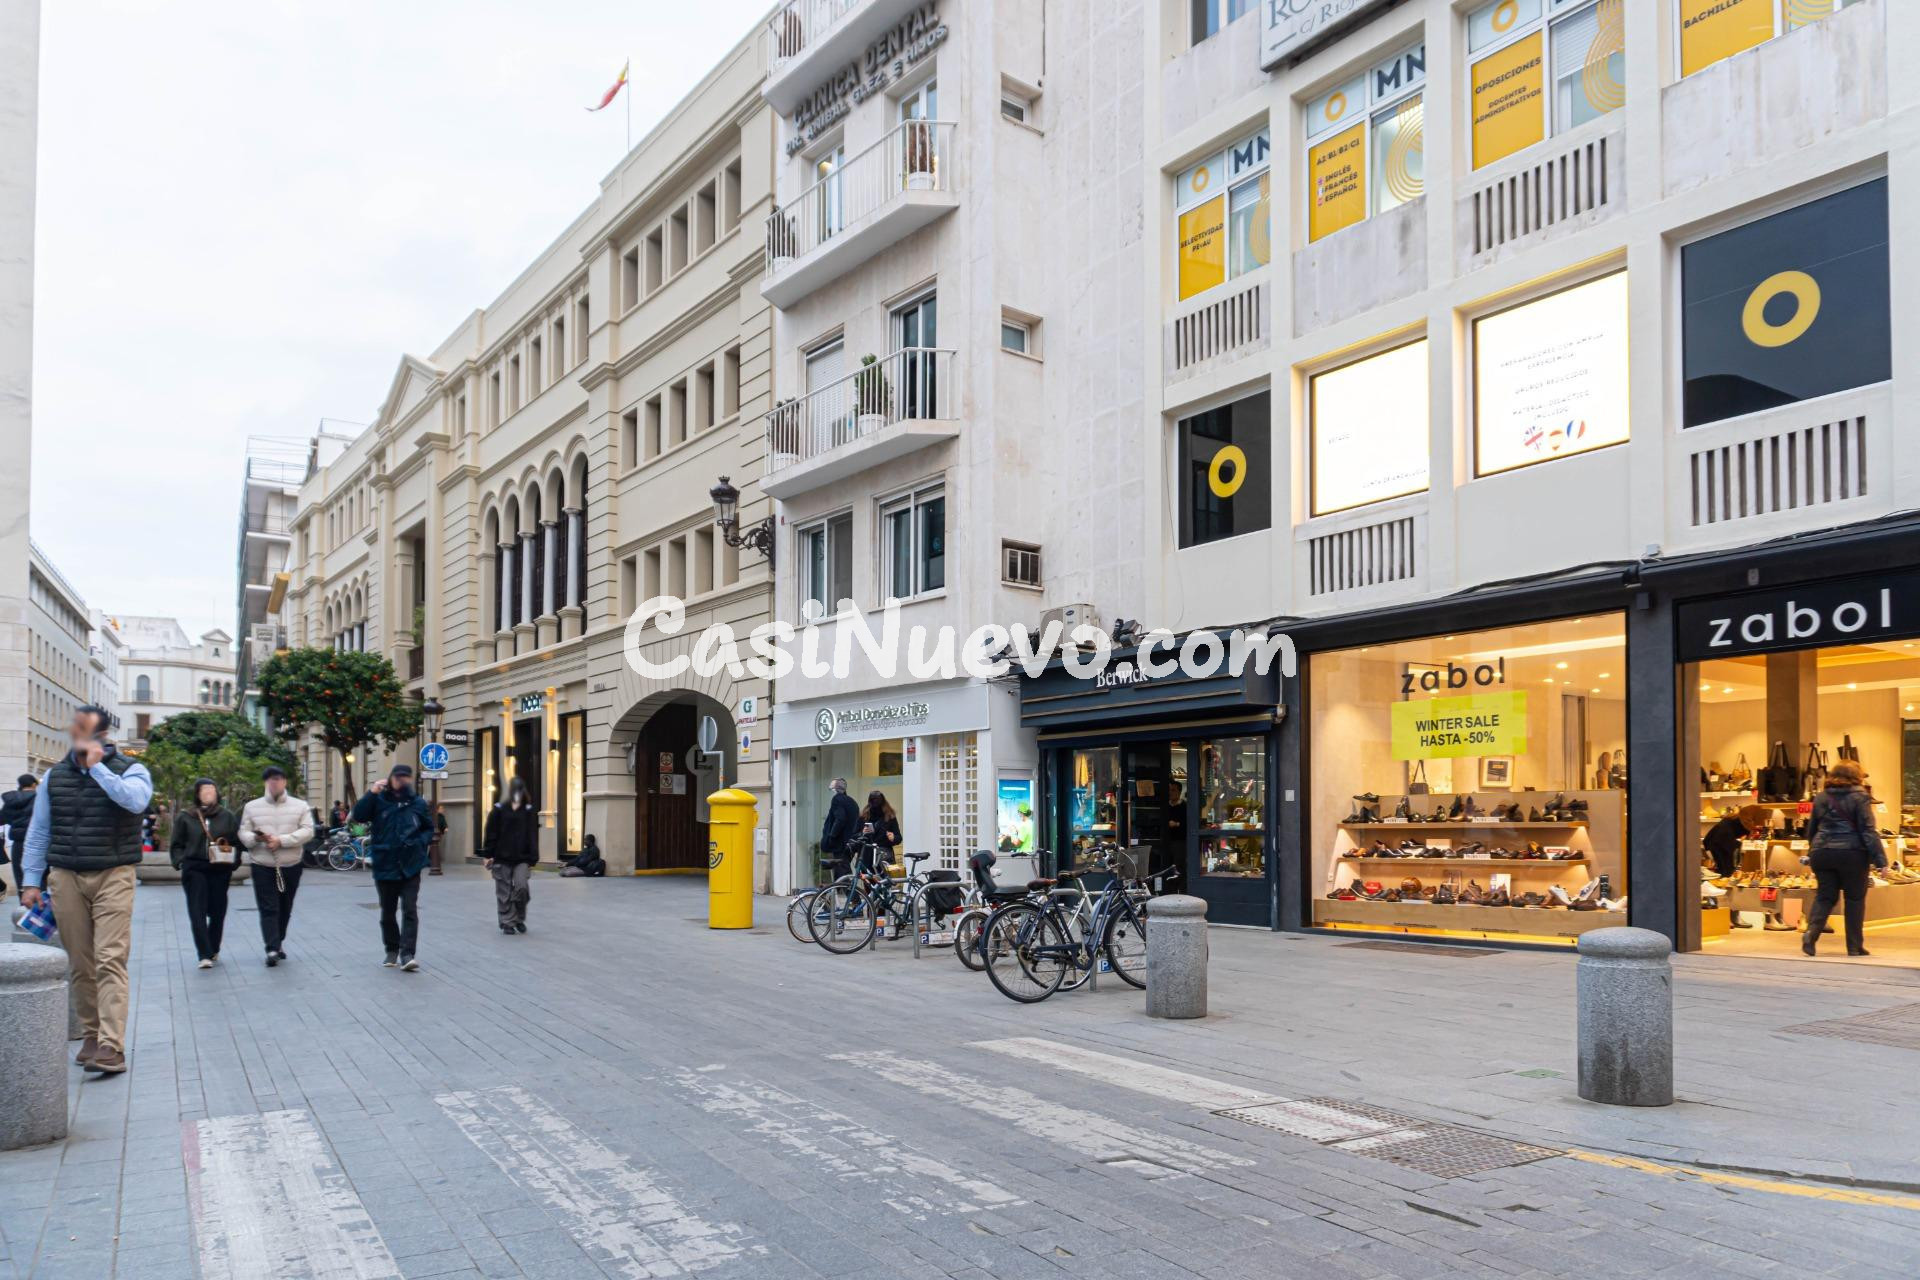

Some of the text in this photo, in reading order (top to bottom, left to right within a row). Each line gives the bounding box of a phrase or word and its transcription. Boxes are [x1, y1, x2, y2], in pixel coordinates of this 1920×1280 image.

[1269, 0, 1317, 30] RO
[864, 1, 940, 74] DENTAL
[1475, 57, 1542, 94] OPOSICIONES
[1474, 88, 1542, 125] ADMINISTRATIVOS
[1488, 86, 1527, 109] DOCENTES
[1325, 164, 1352, 182] INGLÉS
[1325, 171, 1358, 192] FRANCÉS
[1325, 183, 1358, 202] ESPAÑOL
[1180, 223, 1224, 249] SELECTIVIDAD
[1709, 588, 1891, 647] zabol
[1096, 662, 1149, 688] Berwick
[1401, 656, 1505, 693] zabol
[743, 700, 752, 713] G
[1415, 714, 1500, 732] WINTER SALE
[445, 733, 467, 741] noon
[1420, 731, 1495, 747] HASTA -50%
